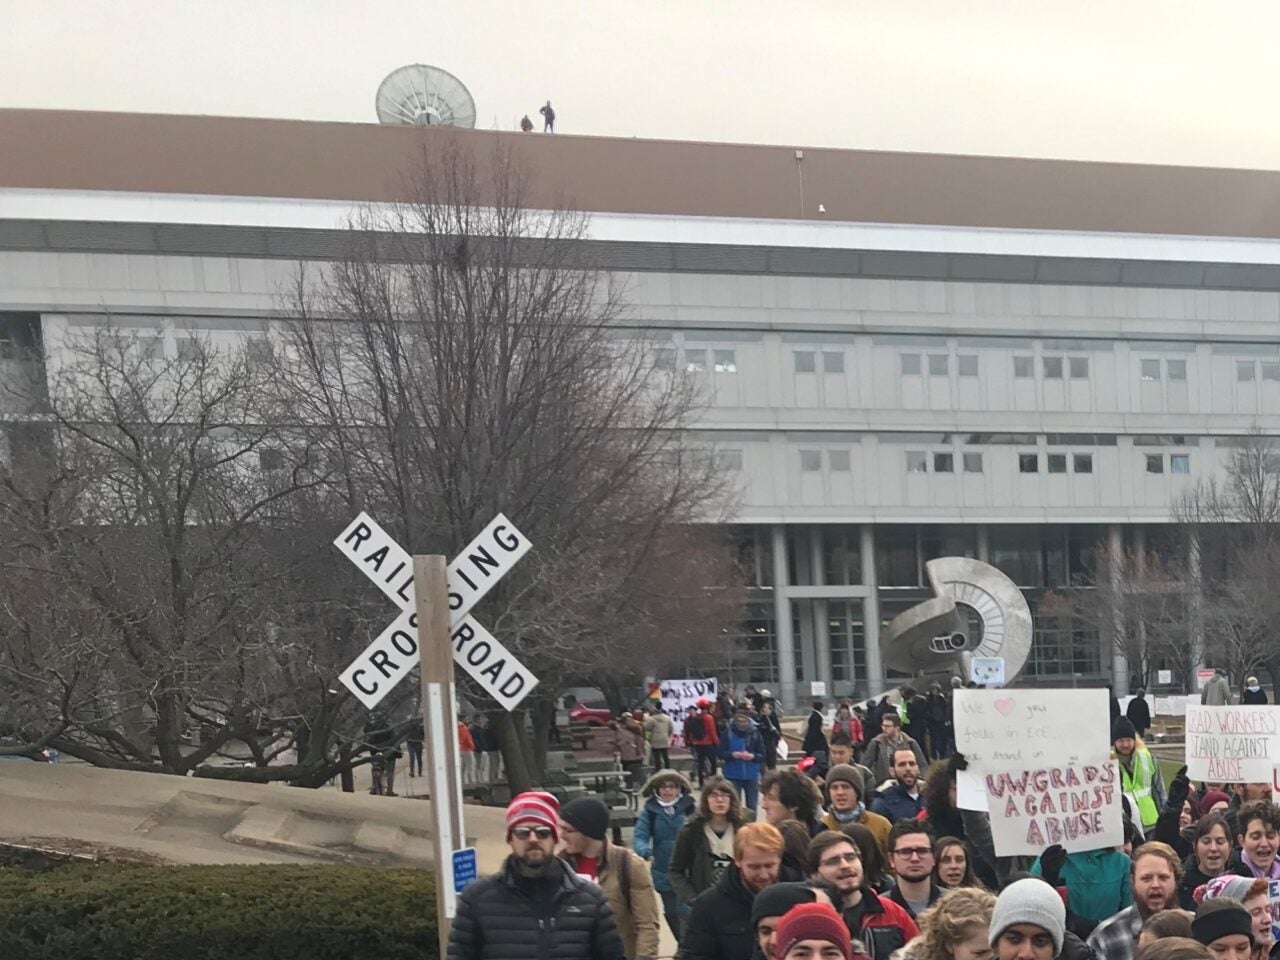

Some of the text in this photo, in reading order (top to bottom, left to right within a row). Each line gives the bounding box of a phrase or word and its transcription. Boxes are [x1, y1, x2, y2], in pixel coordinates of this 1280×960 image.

[344, 521, 525, 699] RAIL ROAD
[1026, 704, 1048, 719] you
[1216, 710, 1278, 733] WORKERS
[1224, 738, 1270, 759] AGAINST
[1208, 759, 1243, 779] ABUSE
[1005, 785, 1114, 818] AGAINST
[1026, 812, 1104, 846] ABUSE
